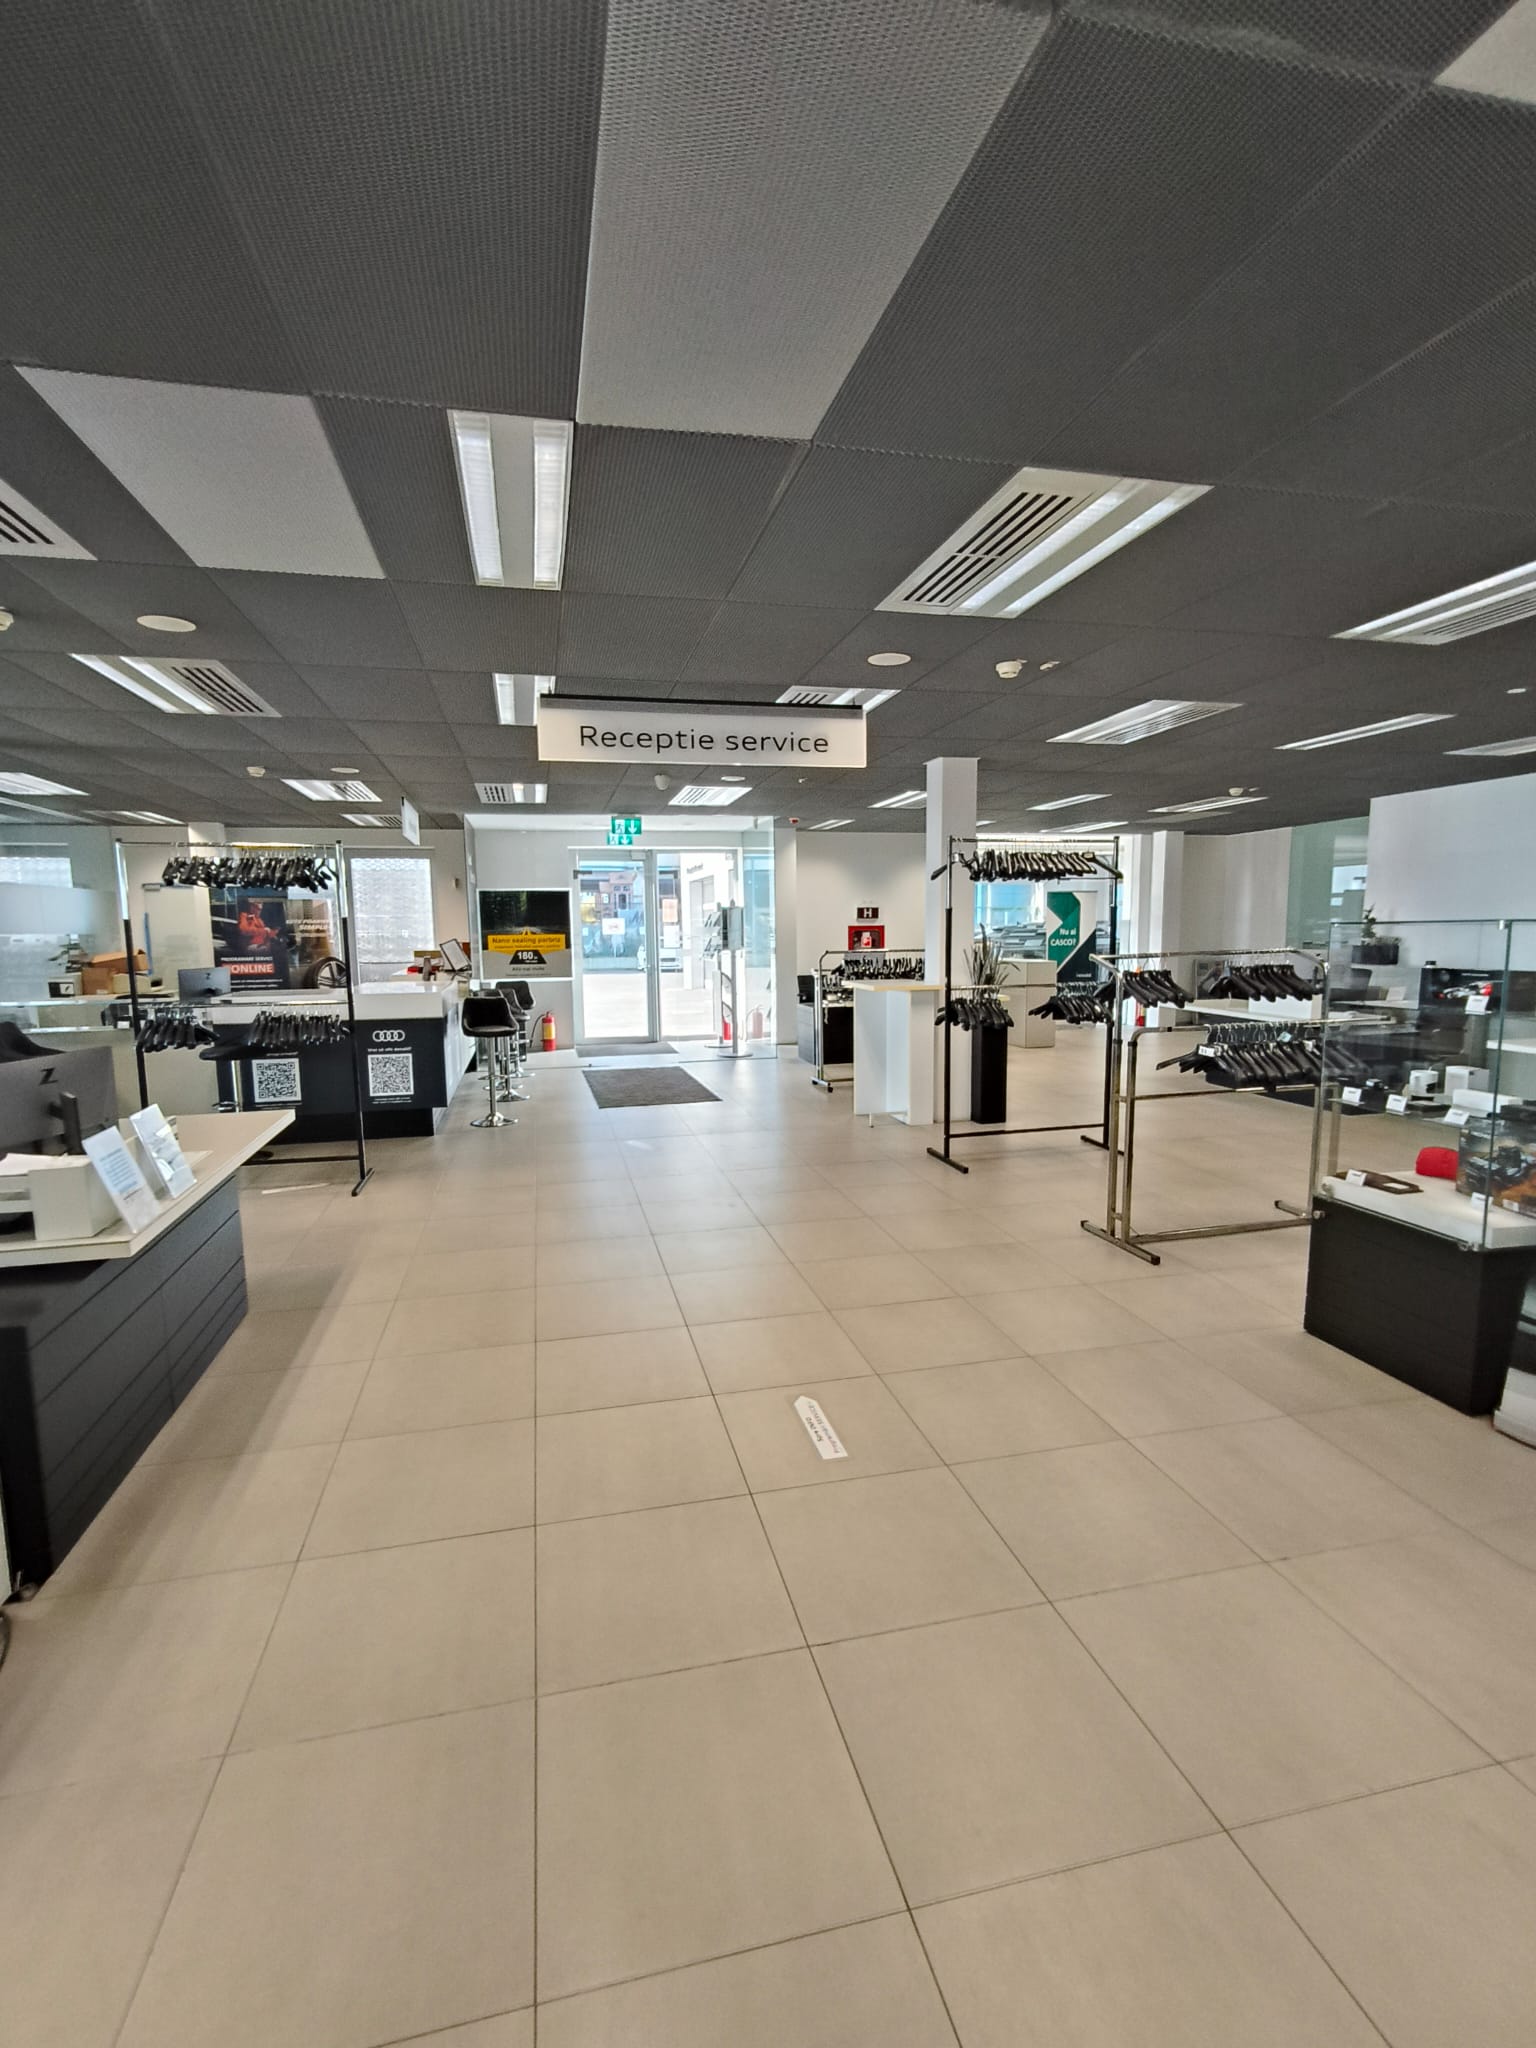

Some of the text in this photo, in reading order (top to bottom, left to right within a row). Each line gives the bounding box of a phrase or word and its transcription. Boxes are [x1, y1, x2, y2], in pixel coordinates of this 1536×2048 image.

[579, 725, 829, 753] Receptie service
[863, 908, 872, 918] H
[1059, 928, 1069, 936] Nu
[1050, 938, 1077, 947] CASCO?
[517, 951, 534, 960] 180
[231, 963, 274, 974] ONLINE
[39, 1067, 58, 1085] Z
